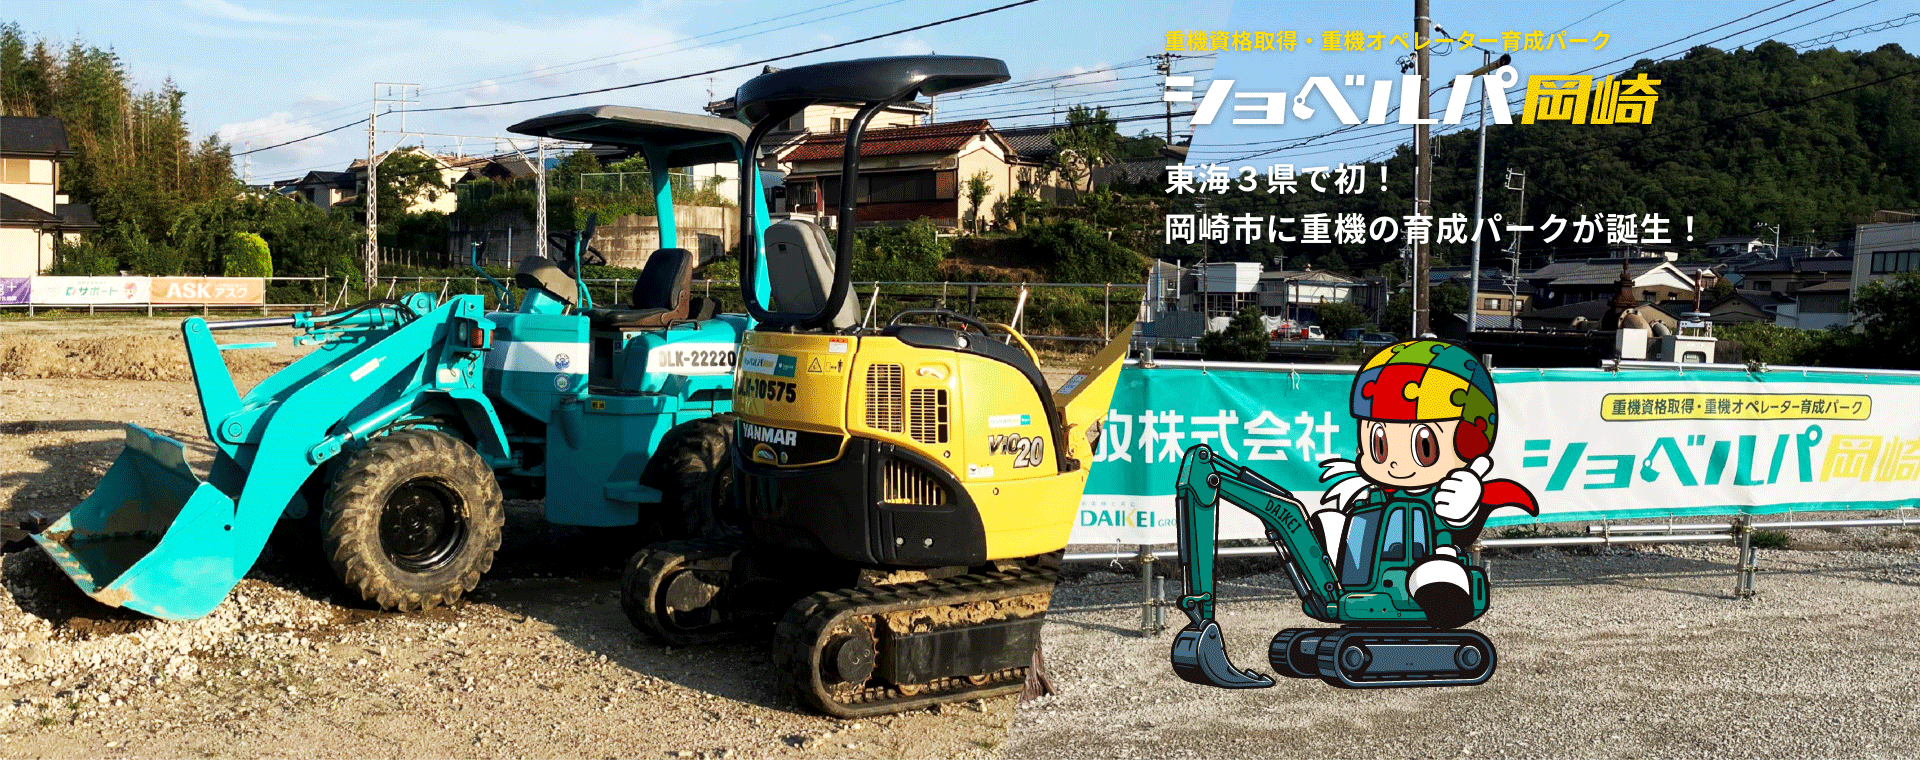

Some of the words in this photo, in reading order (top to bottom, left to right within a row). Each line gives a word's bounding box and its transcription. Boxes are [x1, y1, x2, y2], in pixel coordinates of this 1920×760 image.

[166, 282, 211, 299] ASK
[215, 287, 248, 298] アスク
[1611, 398, 1863, 416] 重機資格取得・重機オペレーター育成パーク
[742, 422, 798, 447] YANMAR
[1080, 509, 1155, 528] DAIKEI
